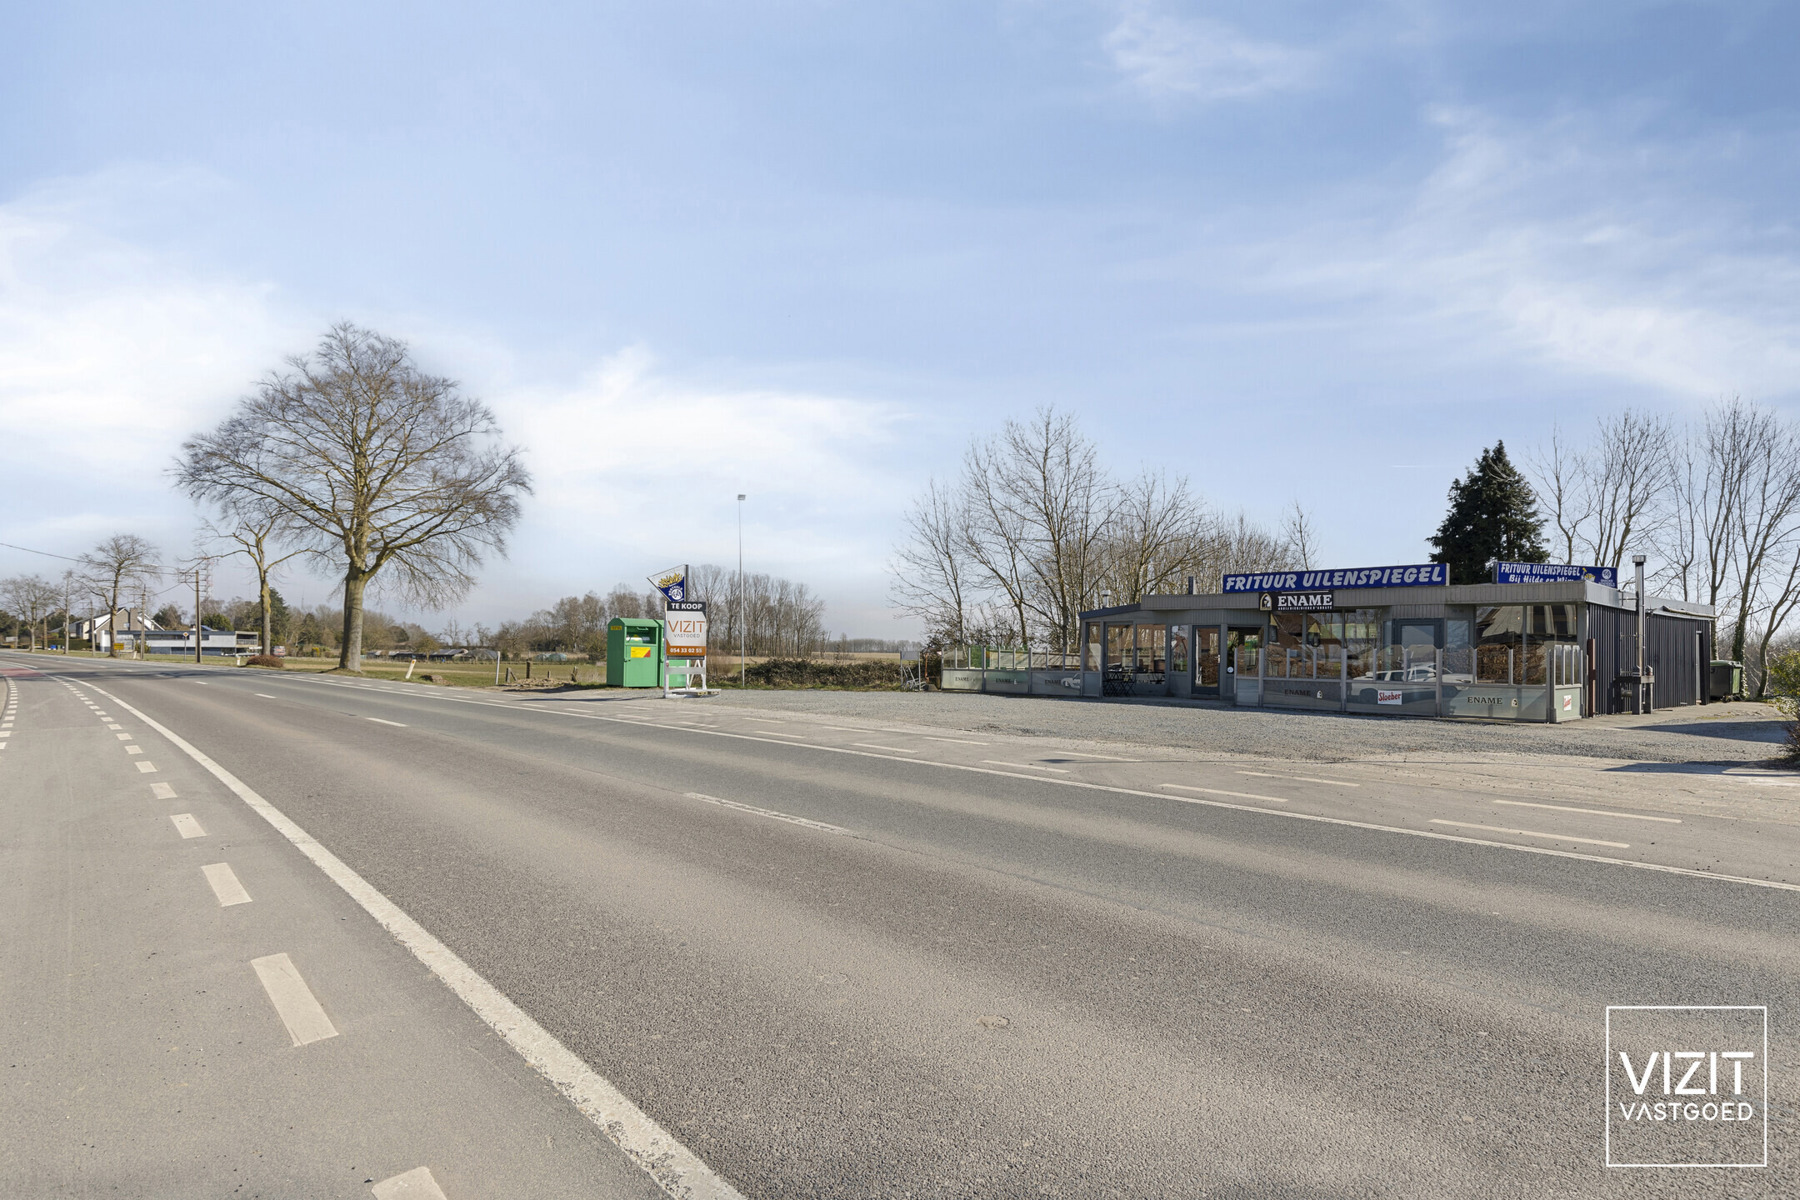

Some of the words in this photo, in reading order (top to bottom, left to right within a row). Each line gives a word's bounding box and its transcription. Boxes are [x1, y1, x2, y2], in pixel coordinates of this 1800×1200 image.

[1501, 563, 1530, 574] FRITUUR
[1532, 565, 1580, 577] UILENSPIEGEL
[1225, 573, 1297, 591] FRITUUR
[1303, 566, 1443, 587] UILENSPIEGEL
[1509, 574, 1520, 584] Bij
[1523, 575, 1544, 583] Hilde
[1277, 594, 1333, 607] ENAME
[668, 620, 705, 632] VIZIT
[1284, 688, 1311, 697] ENAME
[1378, 691, 1402, 702] Sloeber
[1467, 696, 1503, 705] ENAME
